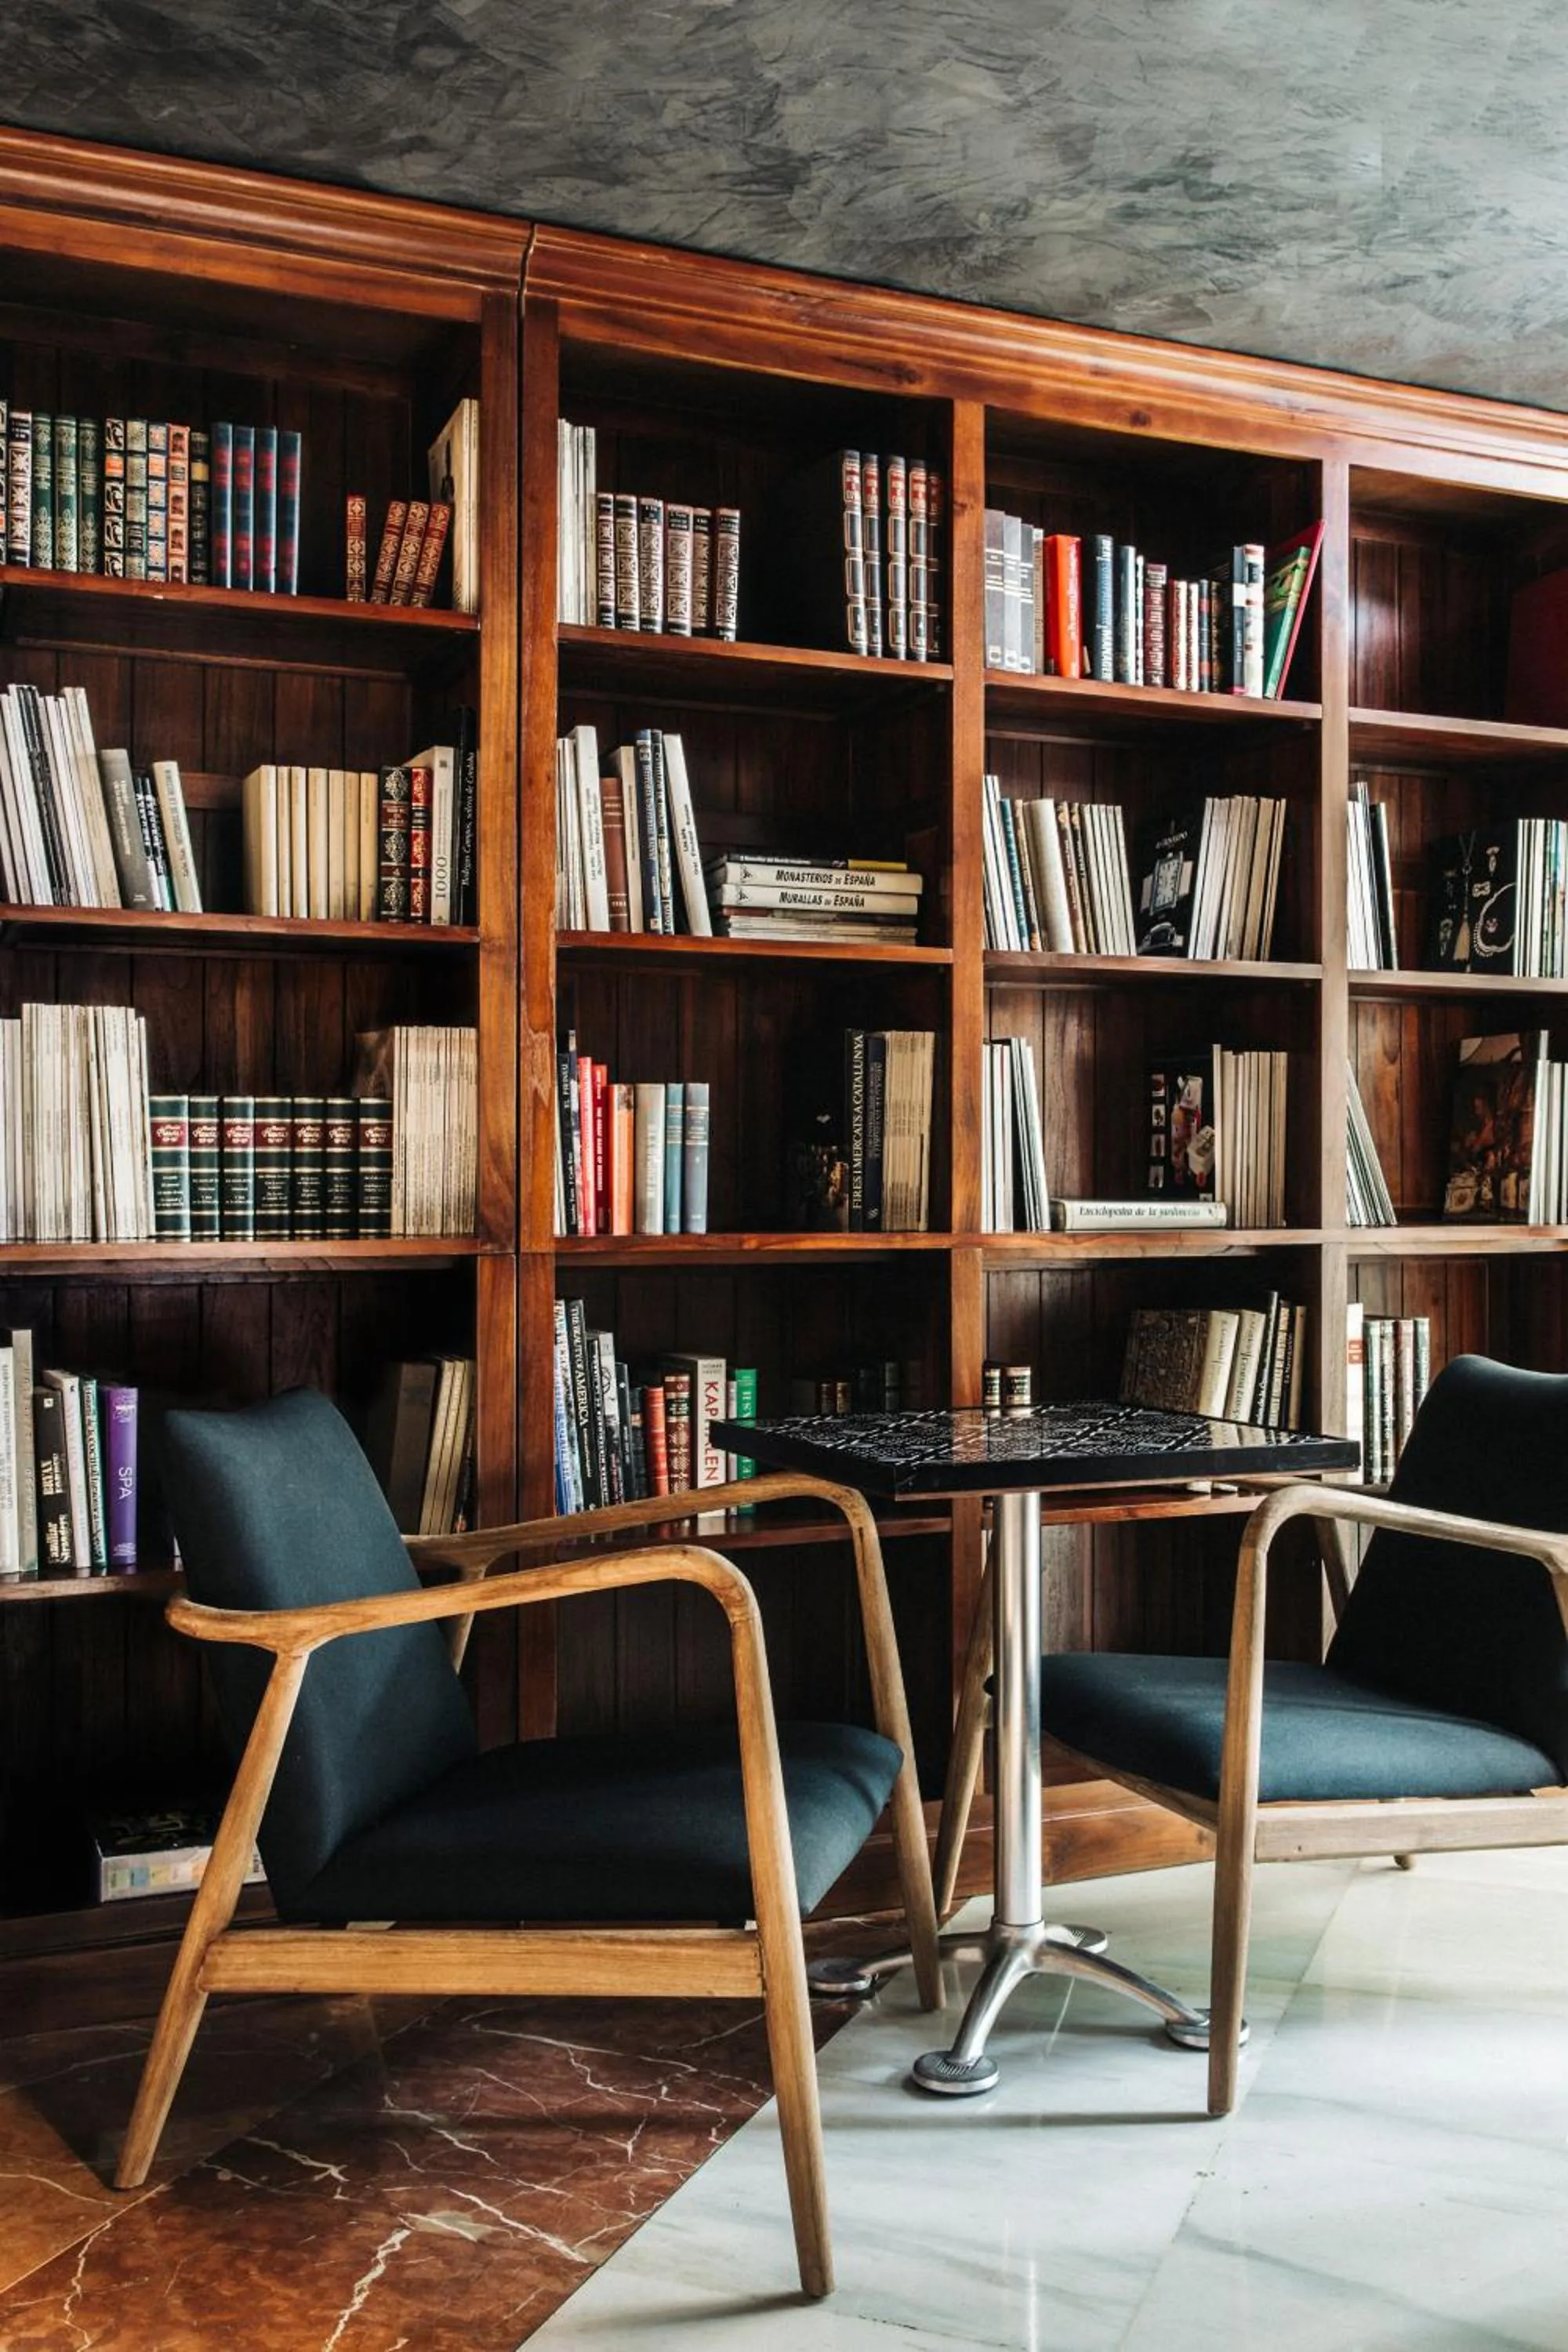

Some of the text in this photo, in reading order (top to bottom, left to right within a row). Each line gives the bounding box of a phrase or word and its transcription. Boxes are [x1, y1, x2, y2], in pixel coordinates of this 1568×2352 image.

[434, 856, 448, 899] 1000
[775, 869, 833, 884] MONASTERIOS
[844, 873, 876, 887] ESPAÑA
[779, 891, 822, 906] MURALLAS
[833, 894, 865, 908] ESPAÑA
[853, 1034, 863, 1104] CATALUNYA
[852, 1115, 862, 1168] MERCATS
[852, 1174, 862, 1209] FIRES
[575, 1370, 589, 1426] AMERICA
[704, 1381, 719, 1480] KAPLEN
[118, 1467, 132, 1500] SPA
